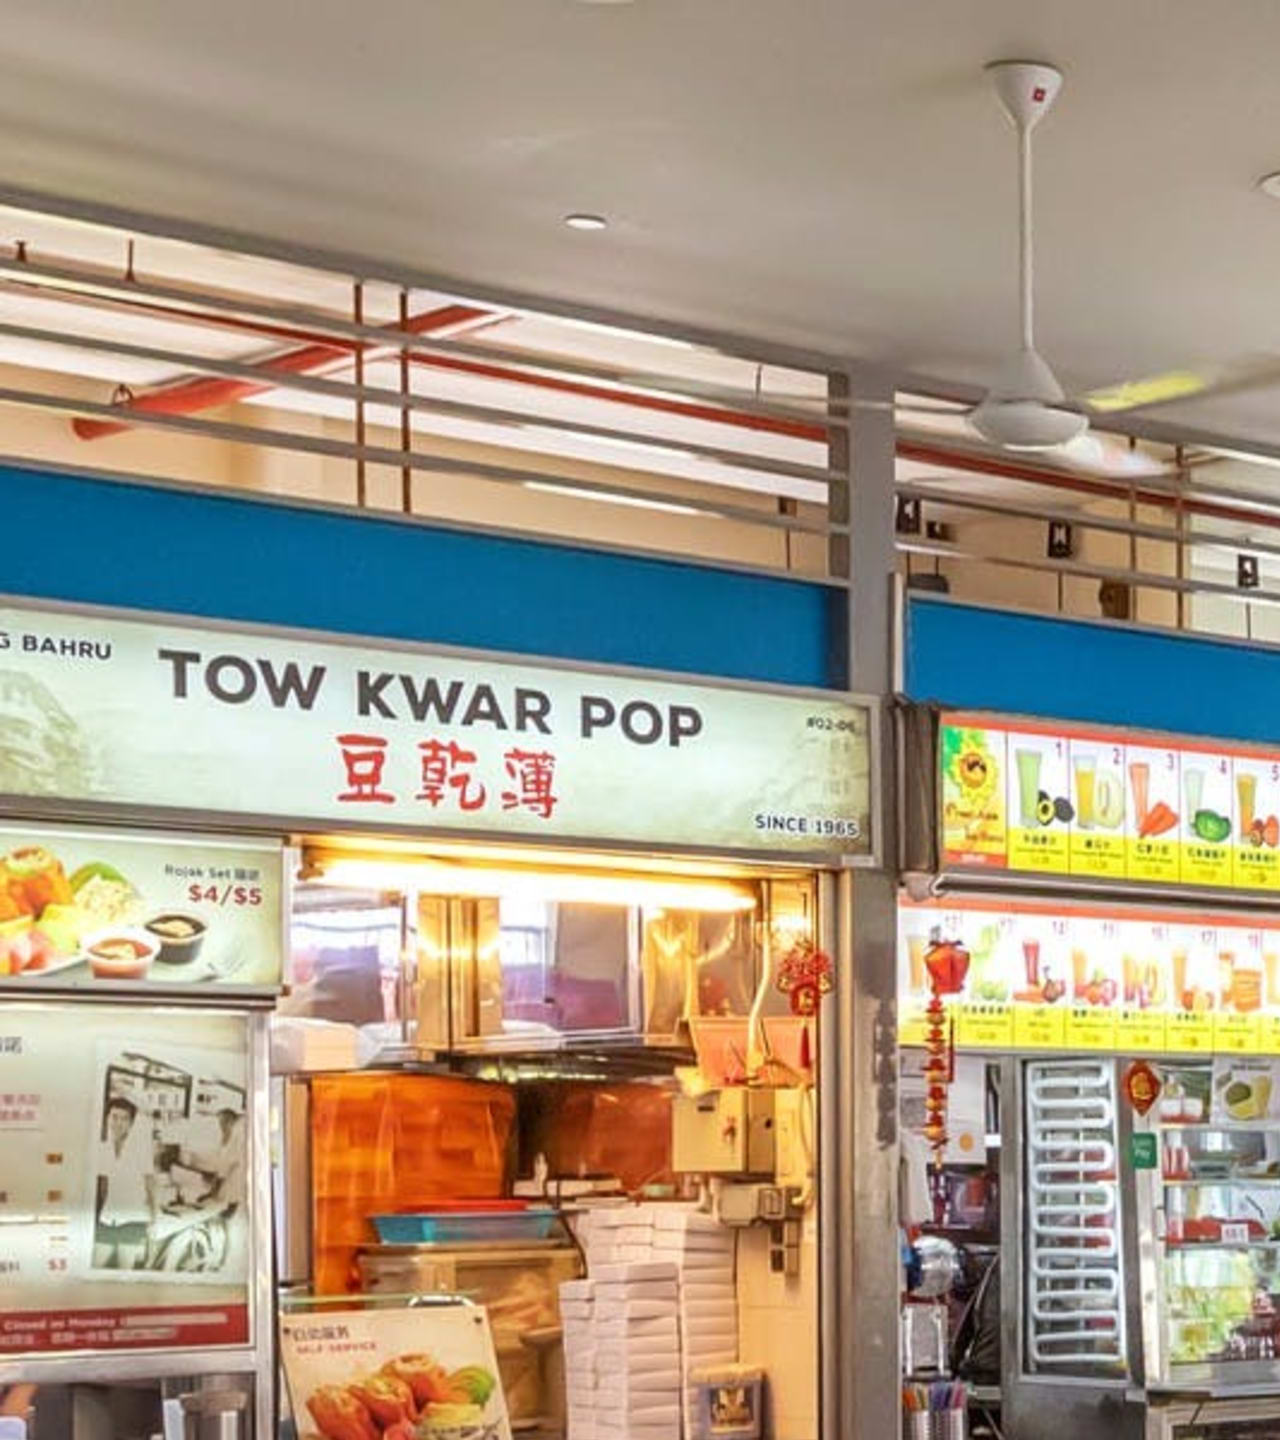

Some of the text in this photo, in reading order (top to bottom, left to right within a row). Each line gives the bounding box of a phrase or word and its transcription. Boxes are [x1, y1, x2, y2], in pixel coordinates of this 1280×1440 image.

[23, 635, 112, 660] BAHRU
[158, 648, 704, 748] TOW KWAR POP
[755, 814, 858, 836] SINCE 1965
[188, 884, 262, 906] $4/$5
